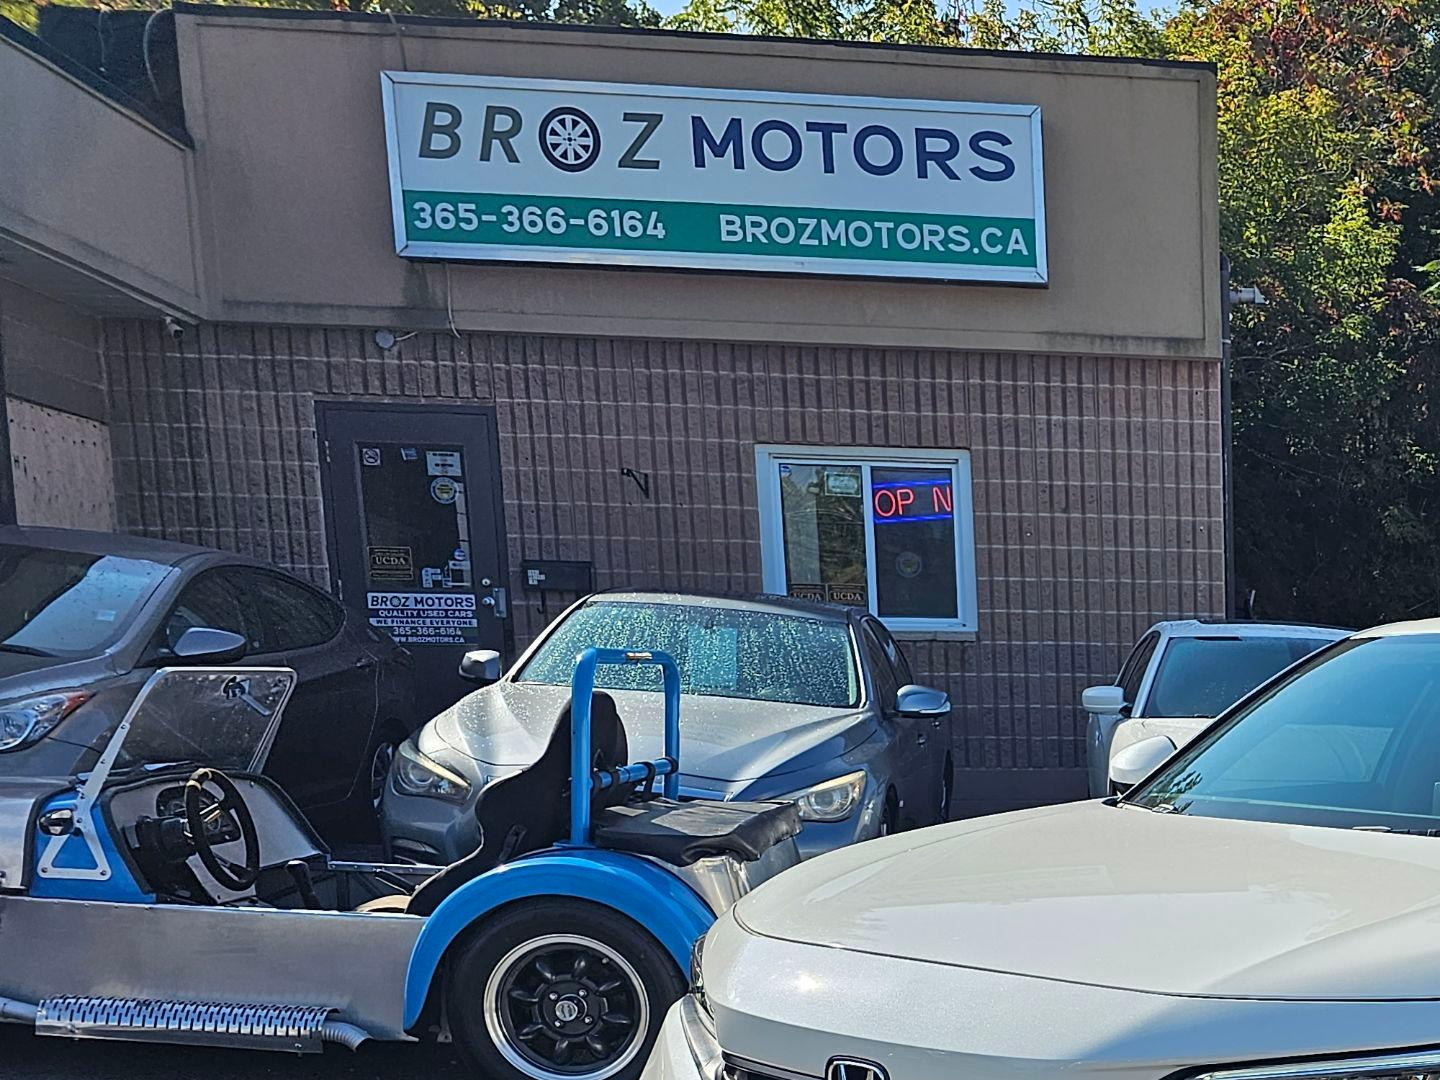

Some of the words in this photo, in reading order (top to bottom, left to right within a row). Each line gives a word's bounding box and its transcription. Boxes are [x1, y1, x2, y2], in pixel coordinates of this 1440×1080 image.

[418, 101, 664, 173] BROZ
[690, 115, 1015, 182] MOTORS
[413, 200, 666, 239] 365-366-6164
[720, 213, 1029, 256] BROZMOTORS.CA
[375, 556, 406, 565] UCDA
[833, 592, 861, 600] UCDA
[370, 595, 410, 608] BROZ
[413, 596, 474, 608] MOTORS
[448, 610, 473, 618] CARS
[393, 626, 462, 635] 365-366-6164
